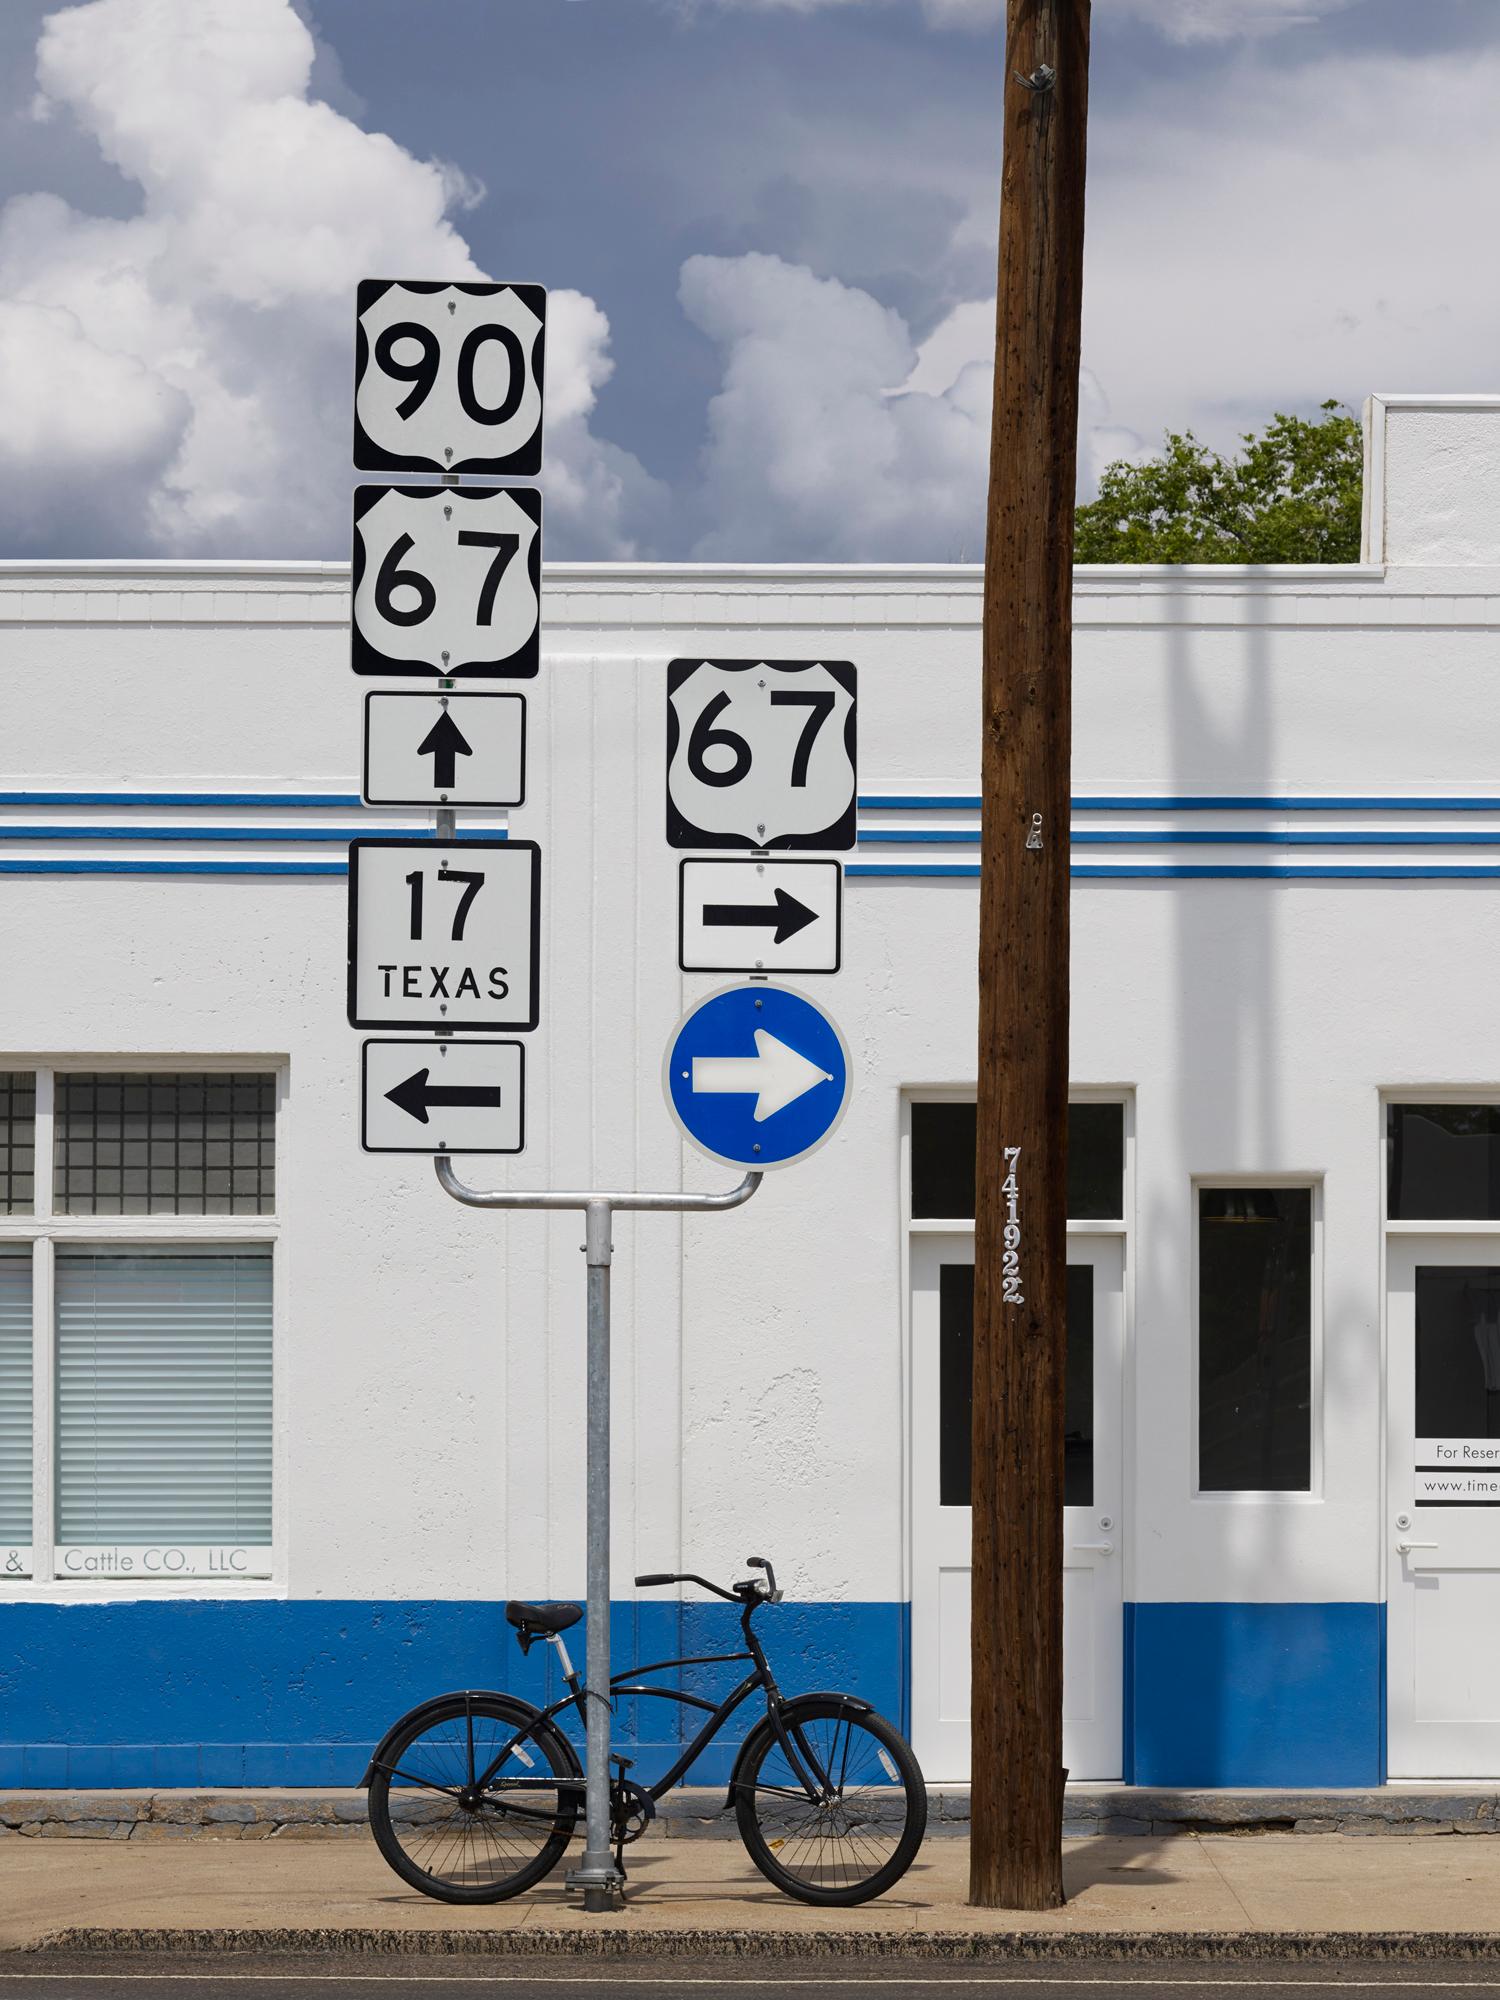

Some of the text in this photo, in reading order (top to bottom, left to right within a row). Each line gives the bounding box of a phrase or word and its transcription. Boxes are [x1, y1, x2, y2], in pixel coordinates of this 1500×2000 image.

[375, 322, 525, 425] 90
[375, 531, 519, 626] 67
[688, 690, 835, 787] 67
[406, 869, 485, 941] 17
[378, 965, 509, 999] TEXAS
[1002, 1147, 1025, 1304] 741922
[1424, 1479, 1500, 1492] www.time
[1436, 1445, 1458, 1459] For
[5, 1547, 248, 1573] & Cattle CO., LLC
